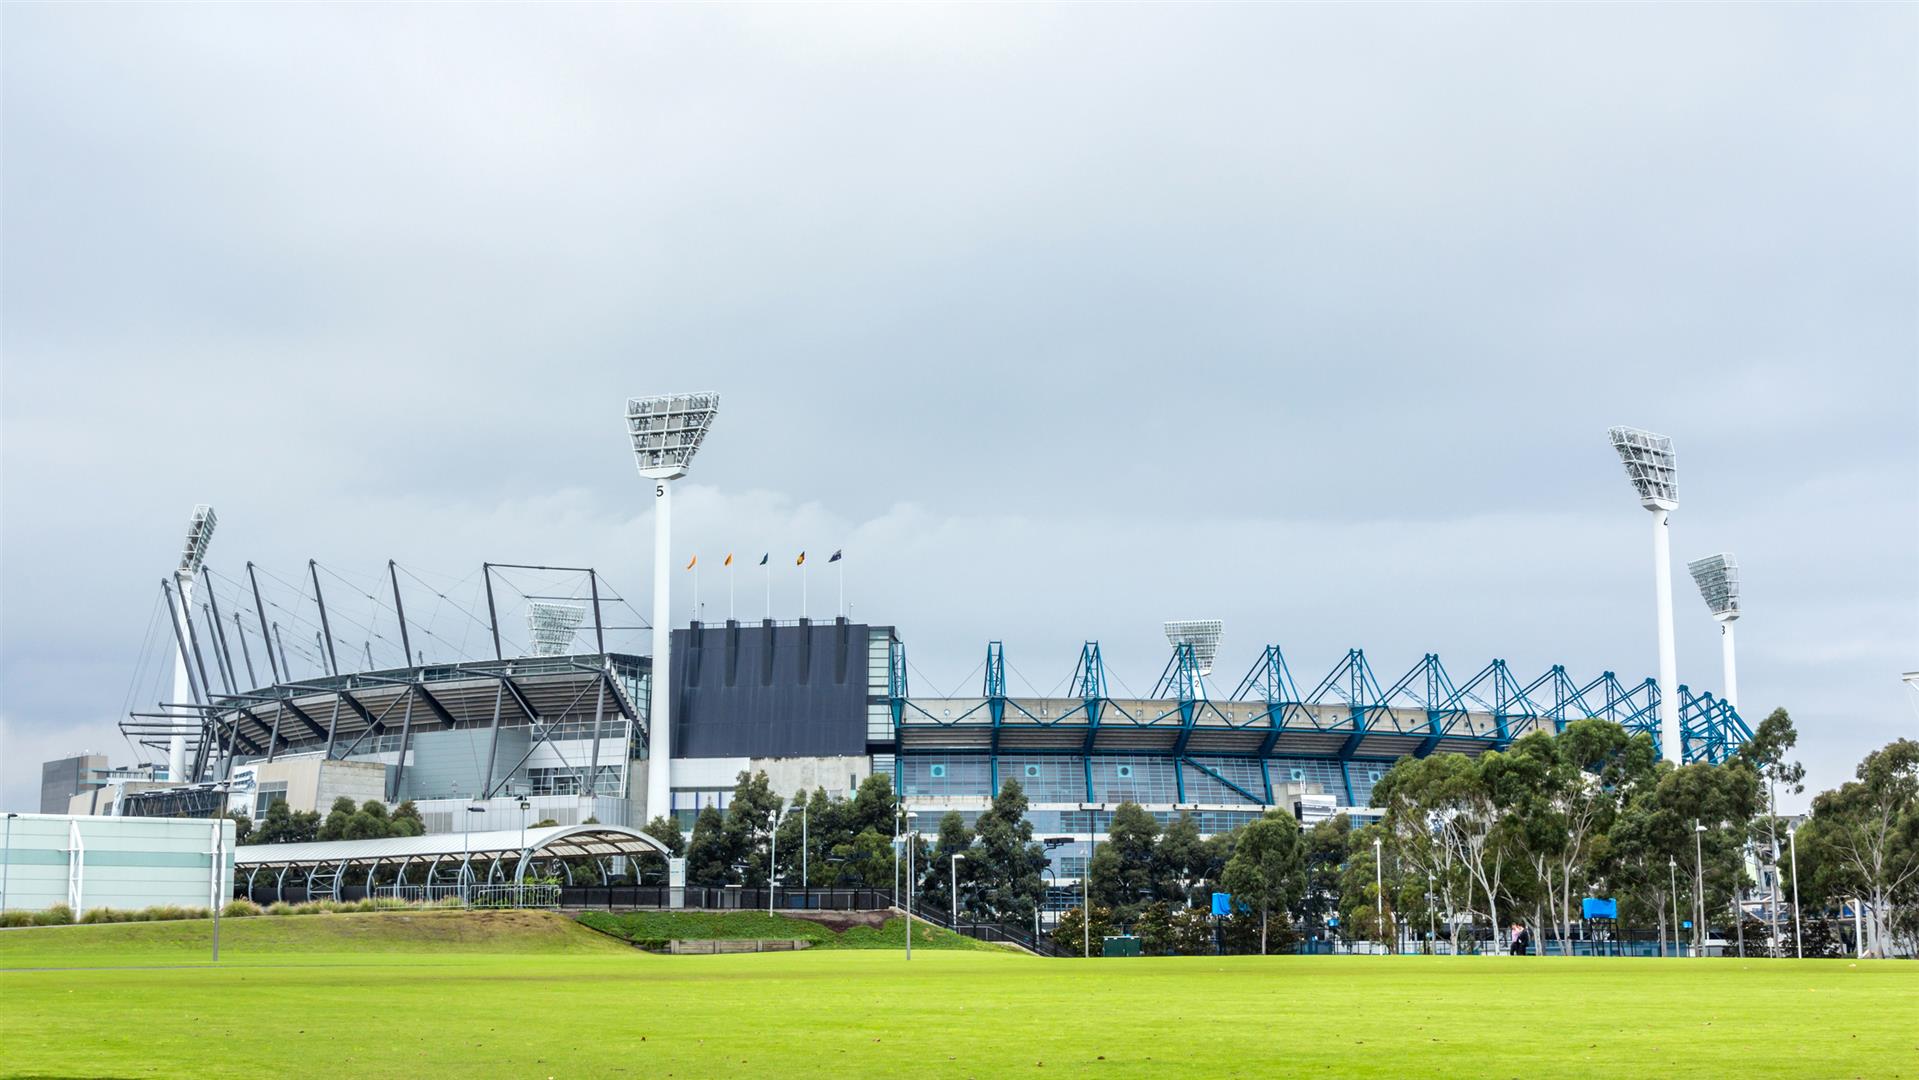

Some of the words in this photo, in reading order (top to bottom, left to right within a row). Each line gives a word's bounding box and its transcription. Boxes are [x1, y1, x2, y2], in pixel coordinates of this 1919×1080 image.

[656, 485, 664, 497] 5
[1721, 625, 1726, 635] 3
[1194, 680, 1200, 688] 2
